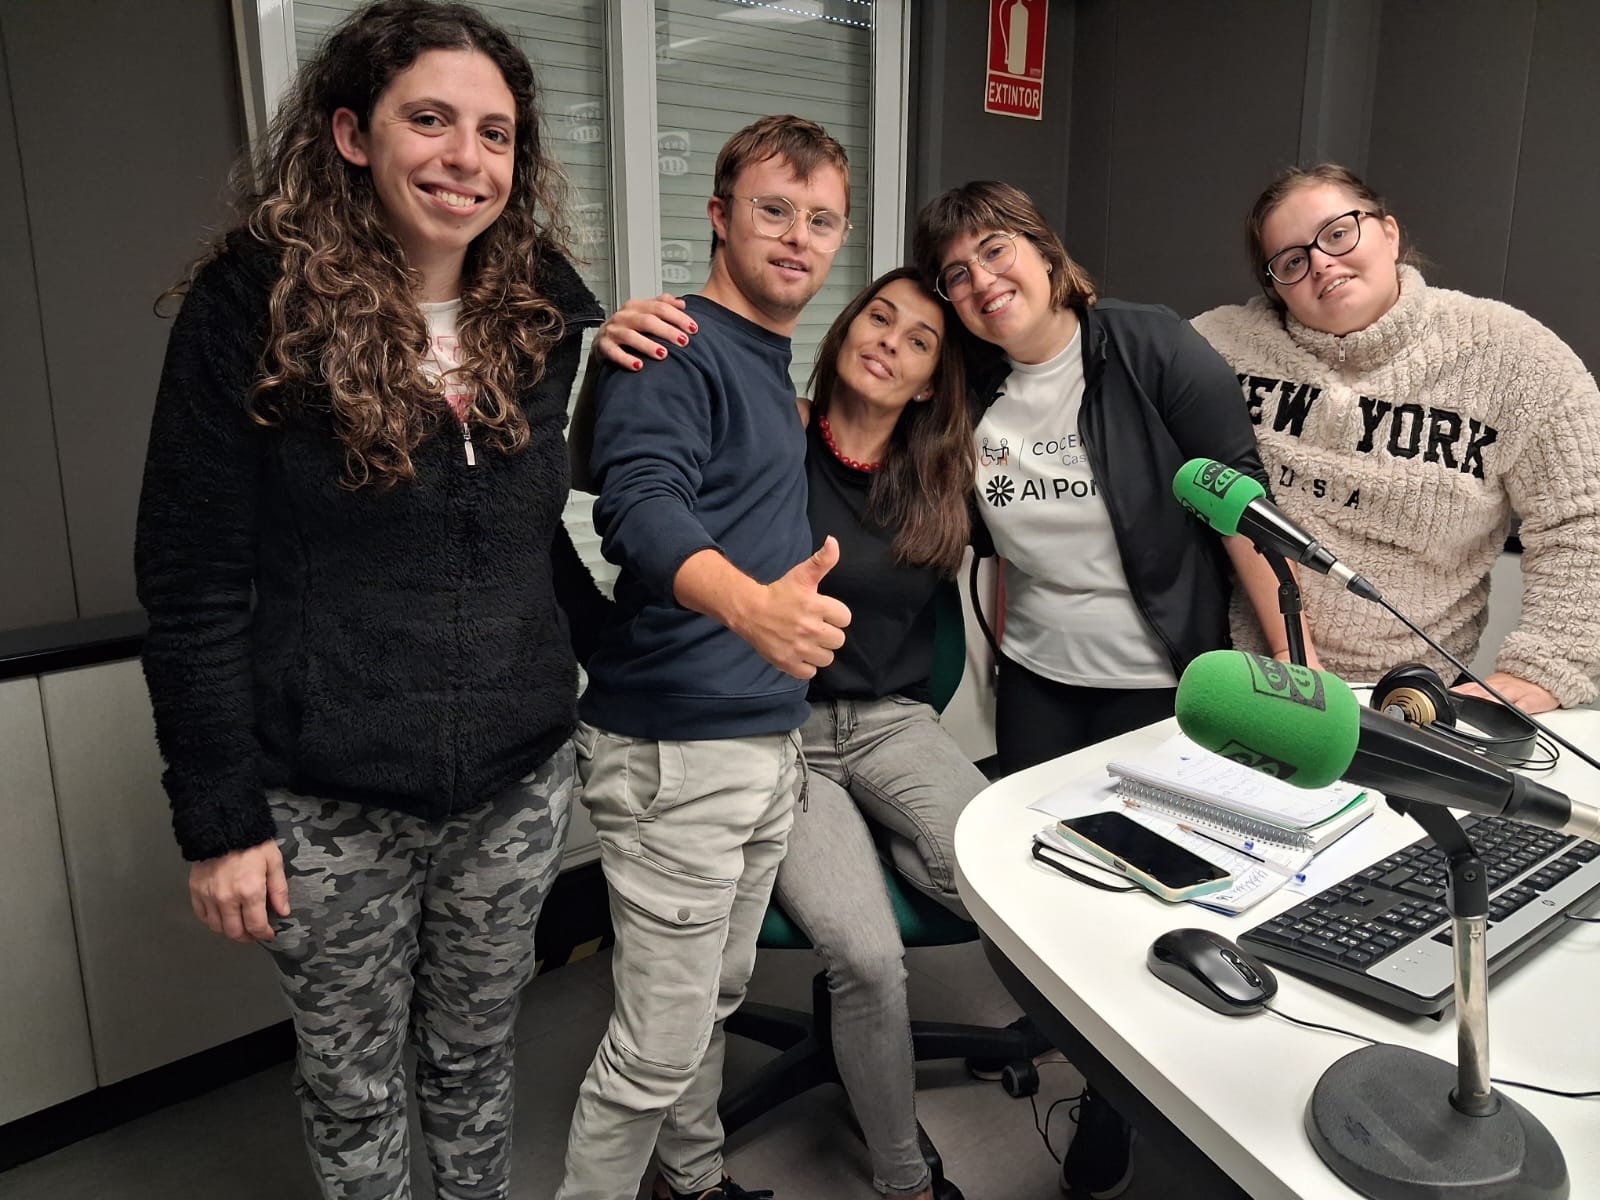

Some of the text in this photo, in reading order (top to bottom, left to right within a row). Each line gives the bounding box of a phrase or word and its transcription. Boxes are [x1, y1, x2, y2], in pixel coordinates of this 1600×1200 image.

[988, 81, 1040, 109] EXTINTOR
[1236, 373, 1499, 480] EW YORK
